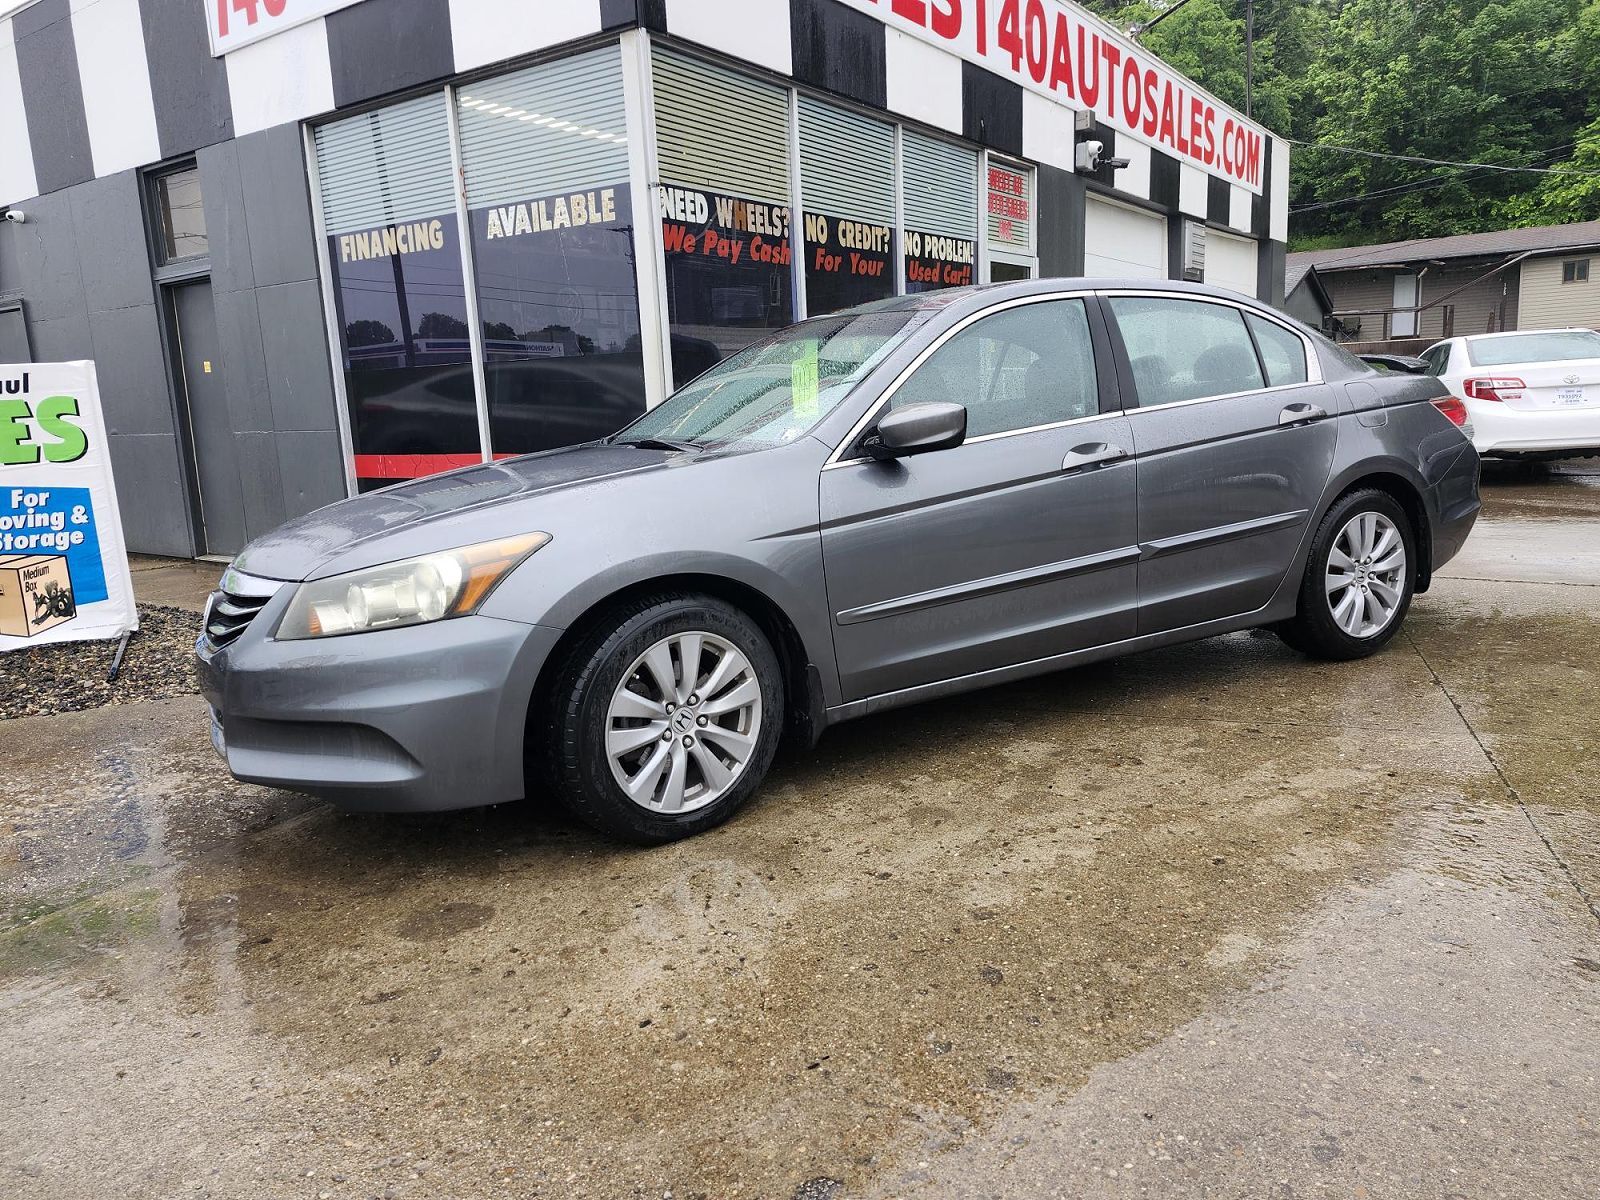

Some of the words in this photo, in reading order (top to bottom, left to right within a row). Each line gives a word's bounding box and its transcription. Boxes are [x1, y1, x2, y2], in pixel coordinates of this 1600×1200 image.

[487, 188, 616, 240] AVAILABLE
[660, 186, 709, 224] NEED
[715, 196, 791, 238] WHEELS?
[340, 219, 444, 263] FINANCING
[663, 223, 696, 253] We
[703, 229, 743, 264] Pay
[750, 235, 792, 265] Cash
[805, 213, 828, 244] NO
[838, 220, 890, 253] CREDIT?
[904, 231, 921, 257] NO
[924, 235, 974, 265] PROBLEM!
[815, 247, 842, 273] For
[850, 252, 884, 277] Your
[909, 260, 940, 285] Used
[943, 264, 971, 285] Car!!
[0, 372, 29, 394] ul
[11, 489, 50, 509] For
[70, 504, 89, 524] &
[23, 565, 50, 581] Medium
[25, 581, 38, 593] Box
